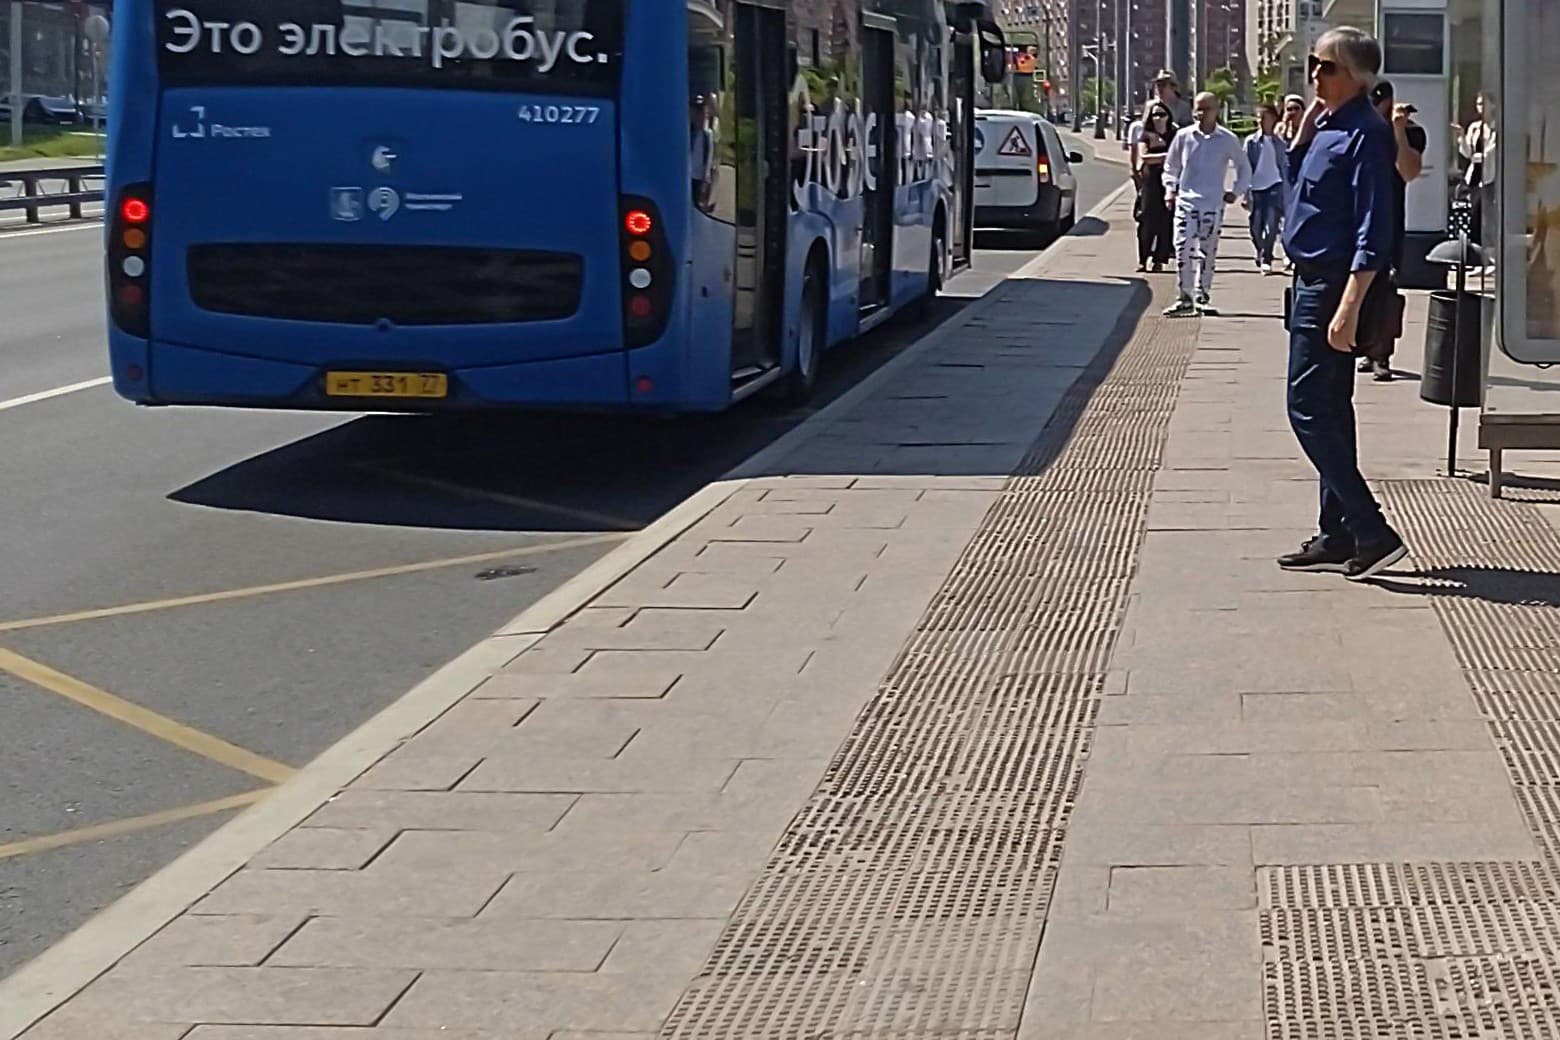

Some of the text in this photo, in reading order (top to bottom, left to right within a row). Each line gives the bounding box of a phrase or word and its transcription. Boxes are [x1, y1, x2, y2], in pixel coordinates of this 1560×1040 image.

[165, 8, 263, 55] Это
[518, 105, 600, 123] 410277
[371, 375, 408, 393] 331
